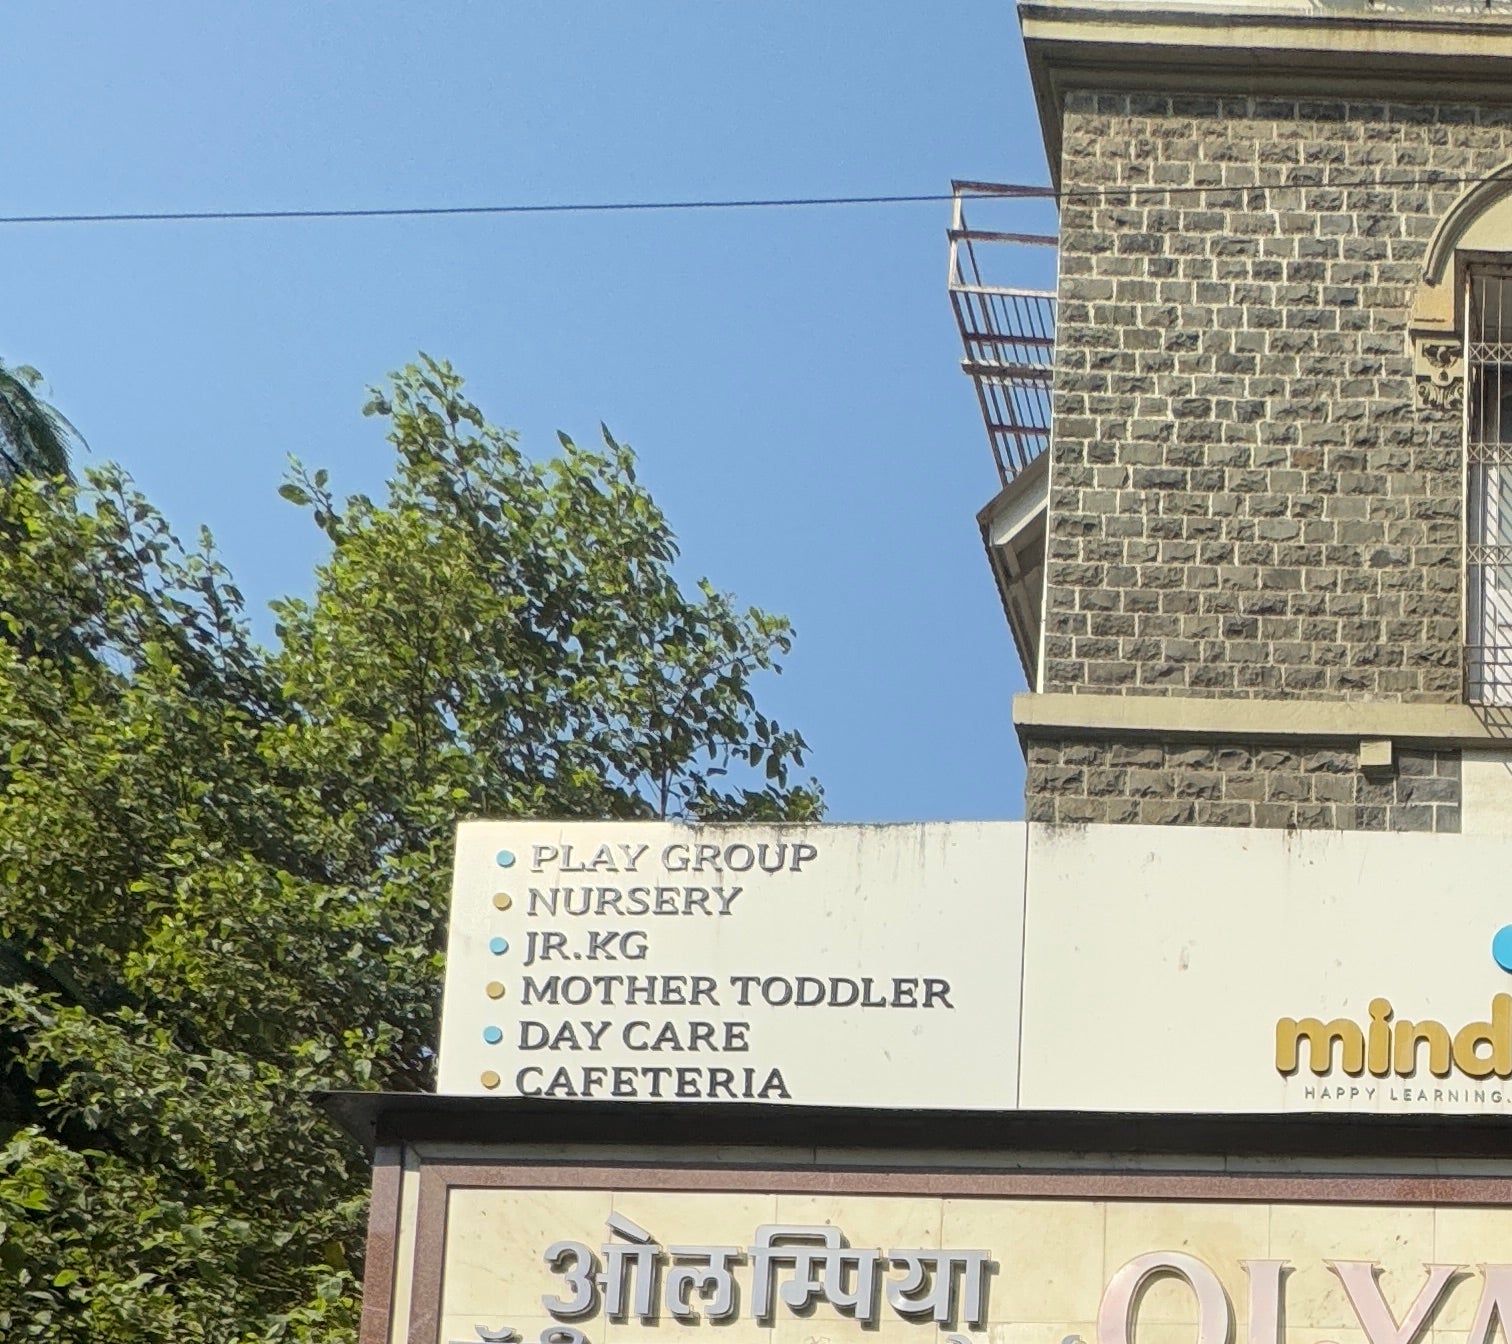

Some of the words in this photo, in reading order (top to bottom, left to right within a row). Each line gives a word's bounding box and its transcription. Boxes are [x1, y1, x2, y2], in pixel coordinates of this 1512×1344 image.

[529, 843, 649, 872] PLAY
[661, 843, 818, 874] GROUP
[526, 886, 743, 916] NURSERY
[523, 930, 649, 966] JR.KG
[521, 975, 721, 1007] MOTHER
[730, 976, 955, 1010] TODDLER
[517, 1020, 613, 1052] DAY
[622, 1021, 750, 1052] CARE
[515, 1066, 792, 1099] CAFETERIA
[1304, 1086, 1377, 1102] HAPPY
[1389, 1087, 1512, 1105] LEARNING.
